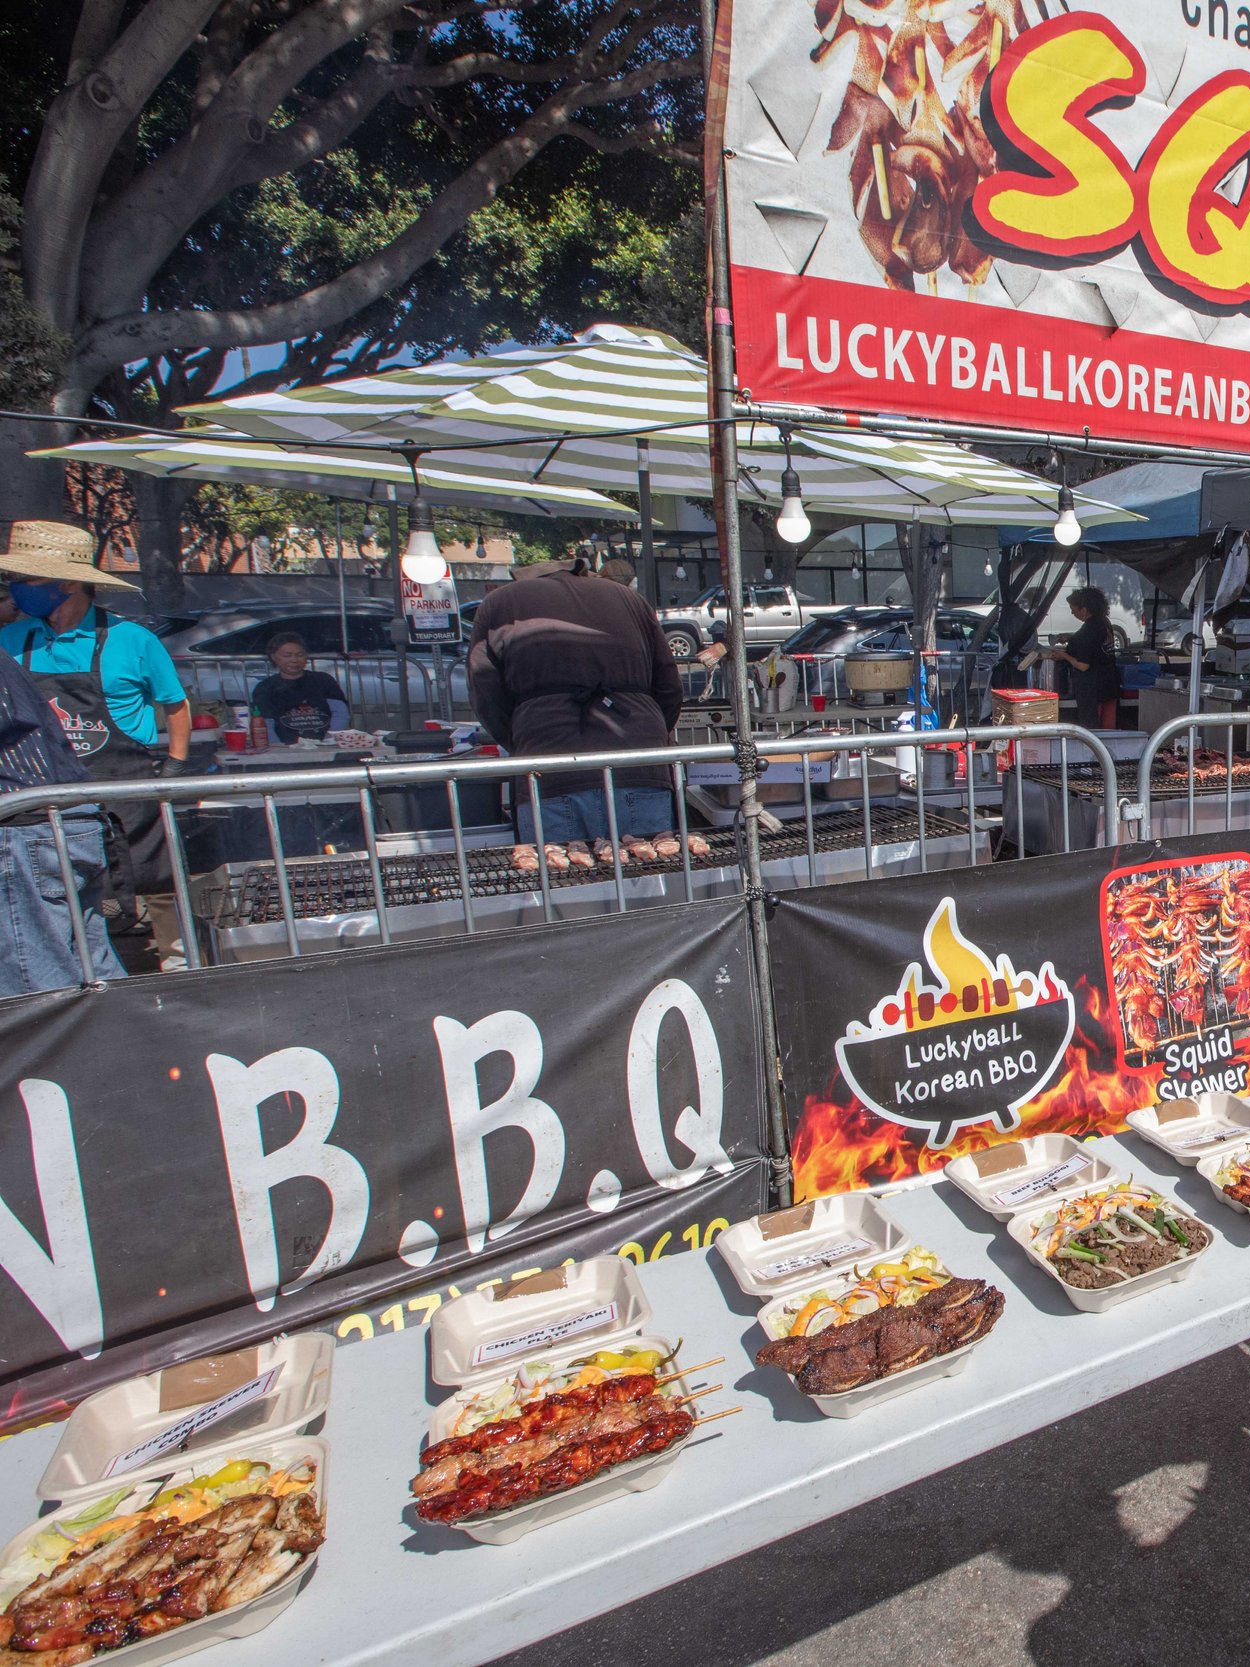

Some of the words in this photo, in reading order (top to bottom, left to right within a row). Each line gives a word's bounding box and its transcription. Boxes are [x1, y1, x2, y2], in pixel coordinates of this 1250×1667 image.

[403, 580, 420, 596] NO
[410, 600, 451, 609] PARKING
[415, 632, 456, 640] TEMPORARY
[1165, 1030, 1233, 1074] Squid
[894, 1067, 984, 1104] Korean
[988, 1050, 1038, 1085] BBQ
[1158, 1064, 1247, 1101] Skewer
[206, 979, 736, 1312] B.B.Q
[1011, 1183, 1031, 1196] BEEF
[1032, 1164, 1070, 1186] BULGOGI
[1032, 1176, 1059, 1191] PLATE
[485, 1330, 545, 1351] CHICKEN
[550, 1309, 607, 1333] TERIYAKI
[527, 1329, 569, 1345] PLATE
[124, 1416, 196, 1461] CHICKEN
[196, 1380, 261, 1419] SKEWER
[158, 1412, 218, 1450] COMBO
